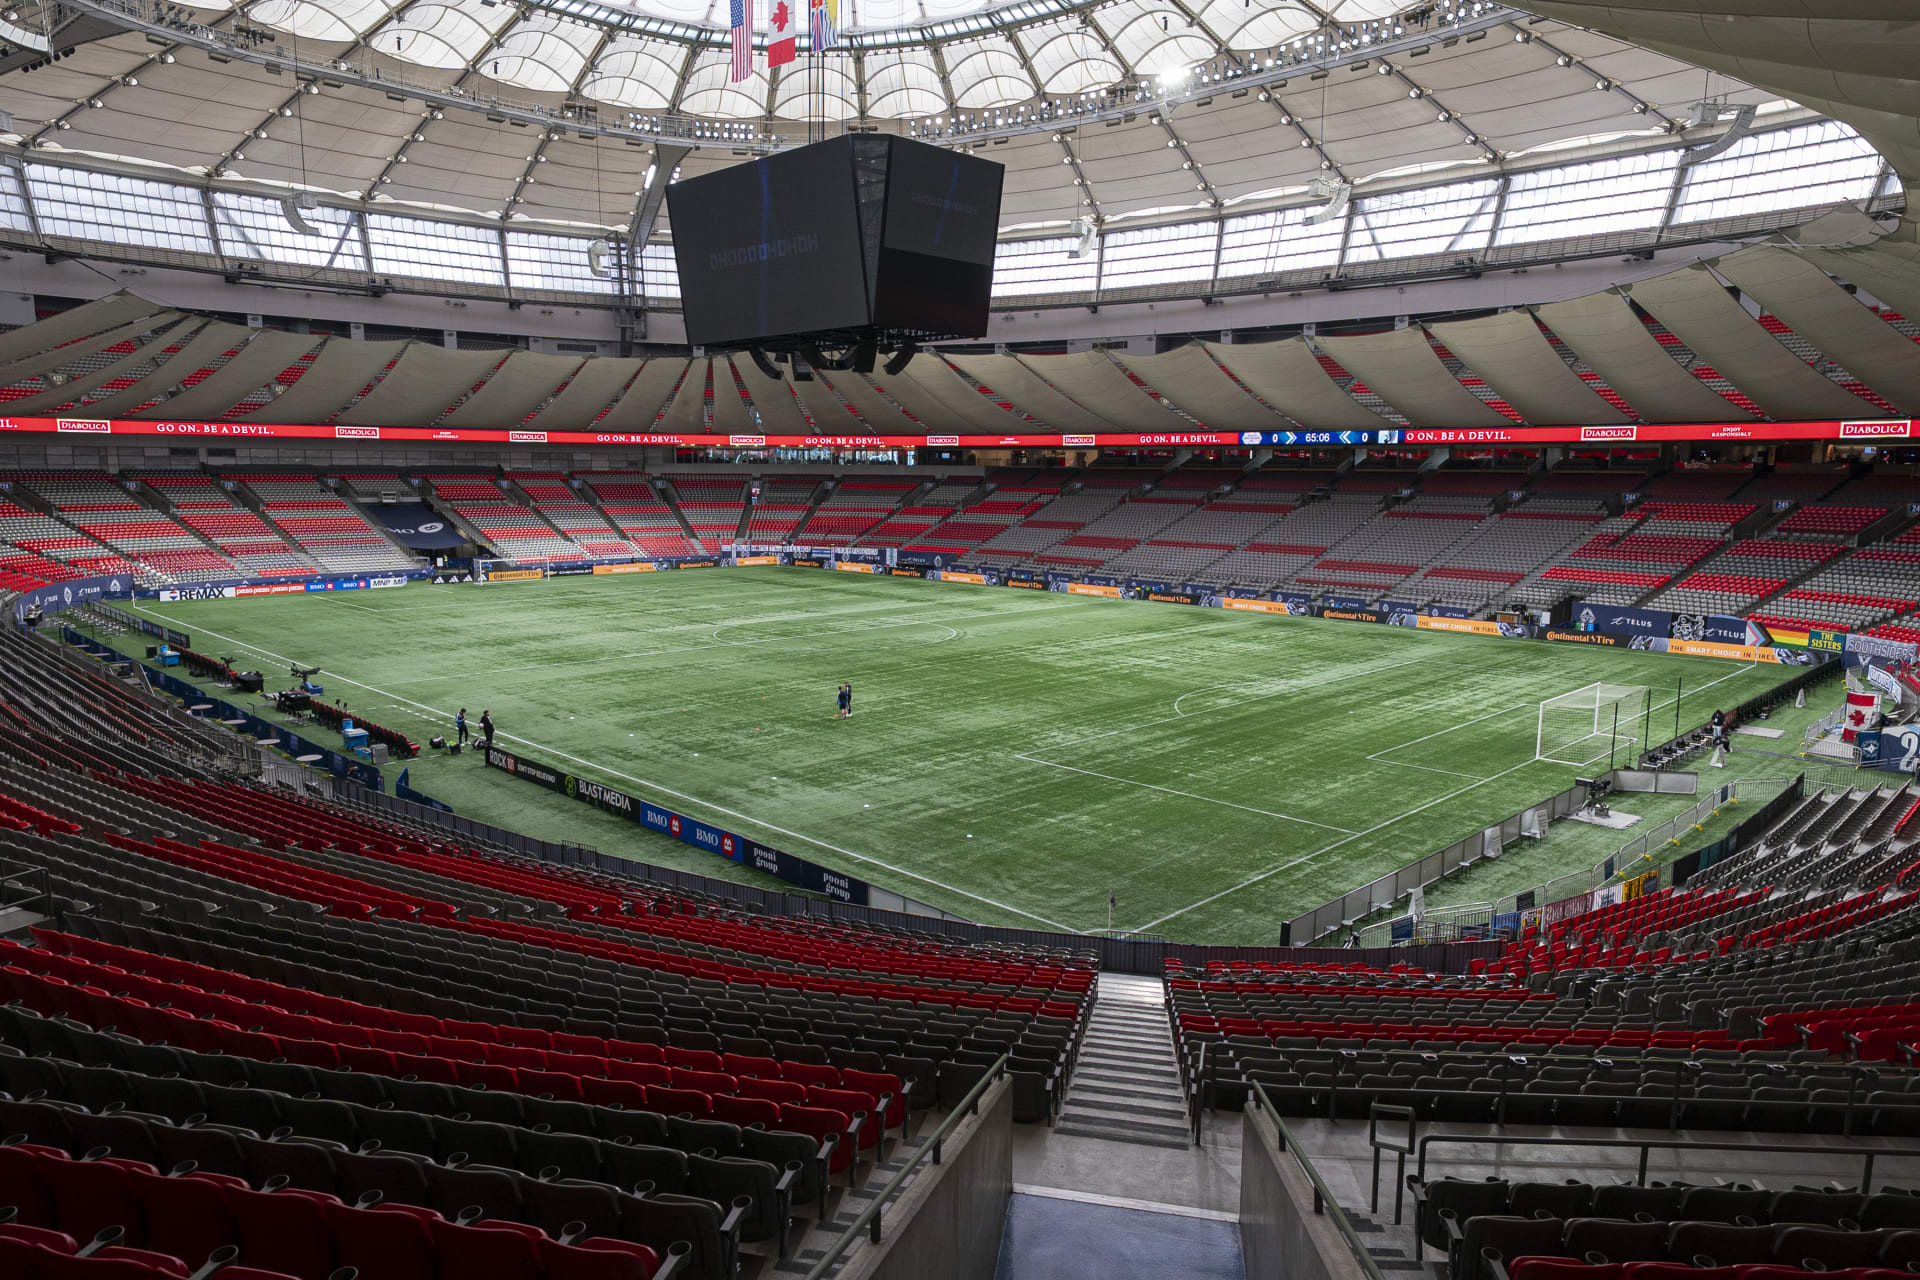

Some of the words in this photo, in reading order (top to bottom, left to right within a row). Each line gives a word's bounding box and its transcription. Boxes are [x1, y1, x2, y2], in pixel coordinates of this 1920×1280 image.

[0, 419, 18, 428] IL.
[61, 422, 107, 430] DIABOLICA
[157, 424, 174, 432] GO
[178, 424, 200, 433] ON.
[204, 425, 218, 433] BE
[222, 425, 229, 433] A
[232, 426, 274, 434] DEVIL.
[339, 428, 376, 436] DIABOLICA
[1585, 429, 1632, 437] DIABOLICA
[1844, 425, 1905, 435] DIABOLICA
[651, 435, 682, 443] DEVIL.
[1190, 435, 1221, 443] DEVIL.
[1305, 433, 1330, 442] 65:06
[1361, 432, 1369, 442] 0
[1417, 432, 1437, 440] ON.
[1441, 432, 1454, 440] BE
[1457, 432, 1465, 440] A
[1469, 431, 1511, 440] DEVIL.
[1323, 610, 1357, 619] Continental
[1362, 613, 1376, 621] Tire
[1626, 618, 1652, 627] TELUS
[1547, 631, 1589, 642] Continental
[1597, 636, 1615, 645] Tire
[1718, 630, 1745, 639] TELUS
[1821, 632, 1834, 641] THE
[1811, 639, 1842, 650] SISTERS
[1849, 640, 1914, 659] SOUTHSIDERS
[1686, 646, 1711, 654] SMART
[1712, 648, 1740, 657] CHOICE
[489, 750, 507, 769] ROCK
[579, 780, 603, 799] BLAST
[603, 790, 631, 811] MEDIA
[647, 810, 668, 828] BMO
[696, 828, 719, 846] BMO
[753, 847, 776, 862] pooni
[756, 857, 778, 873] group
[823, 872, 849, 888] pooni
[825, 883, 850, 901] group
